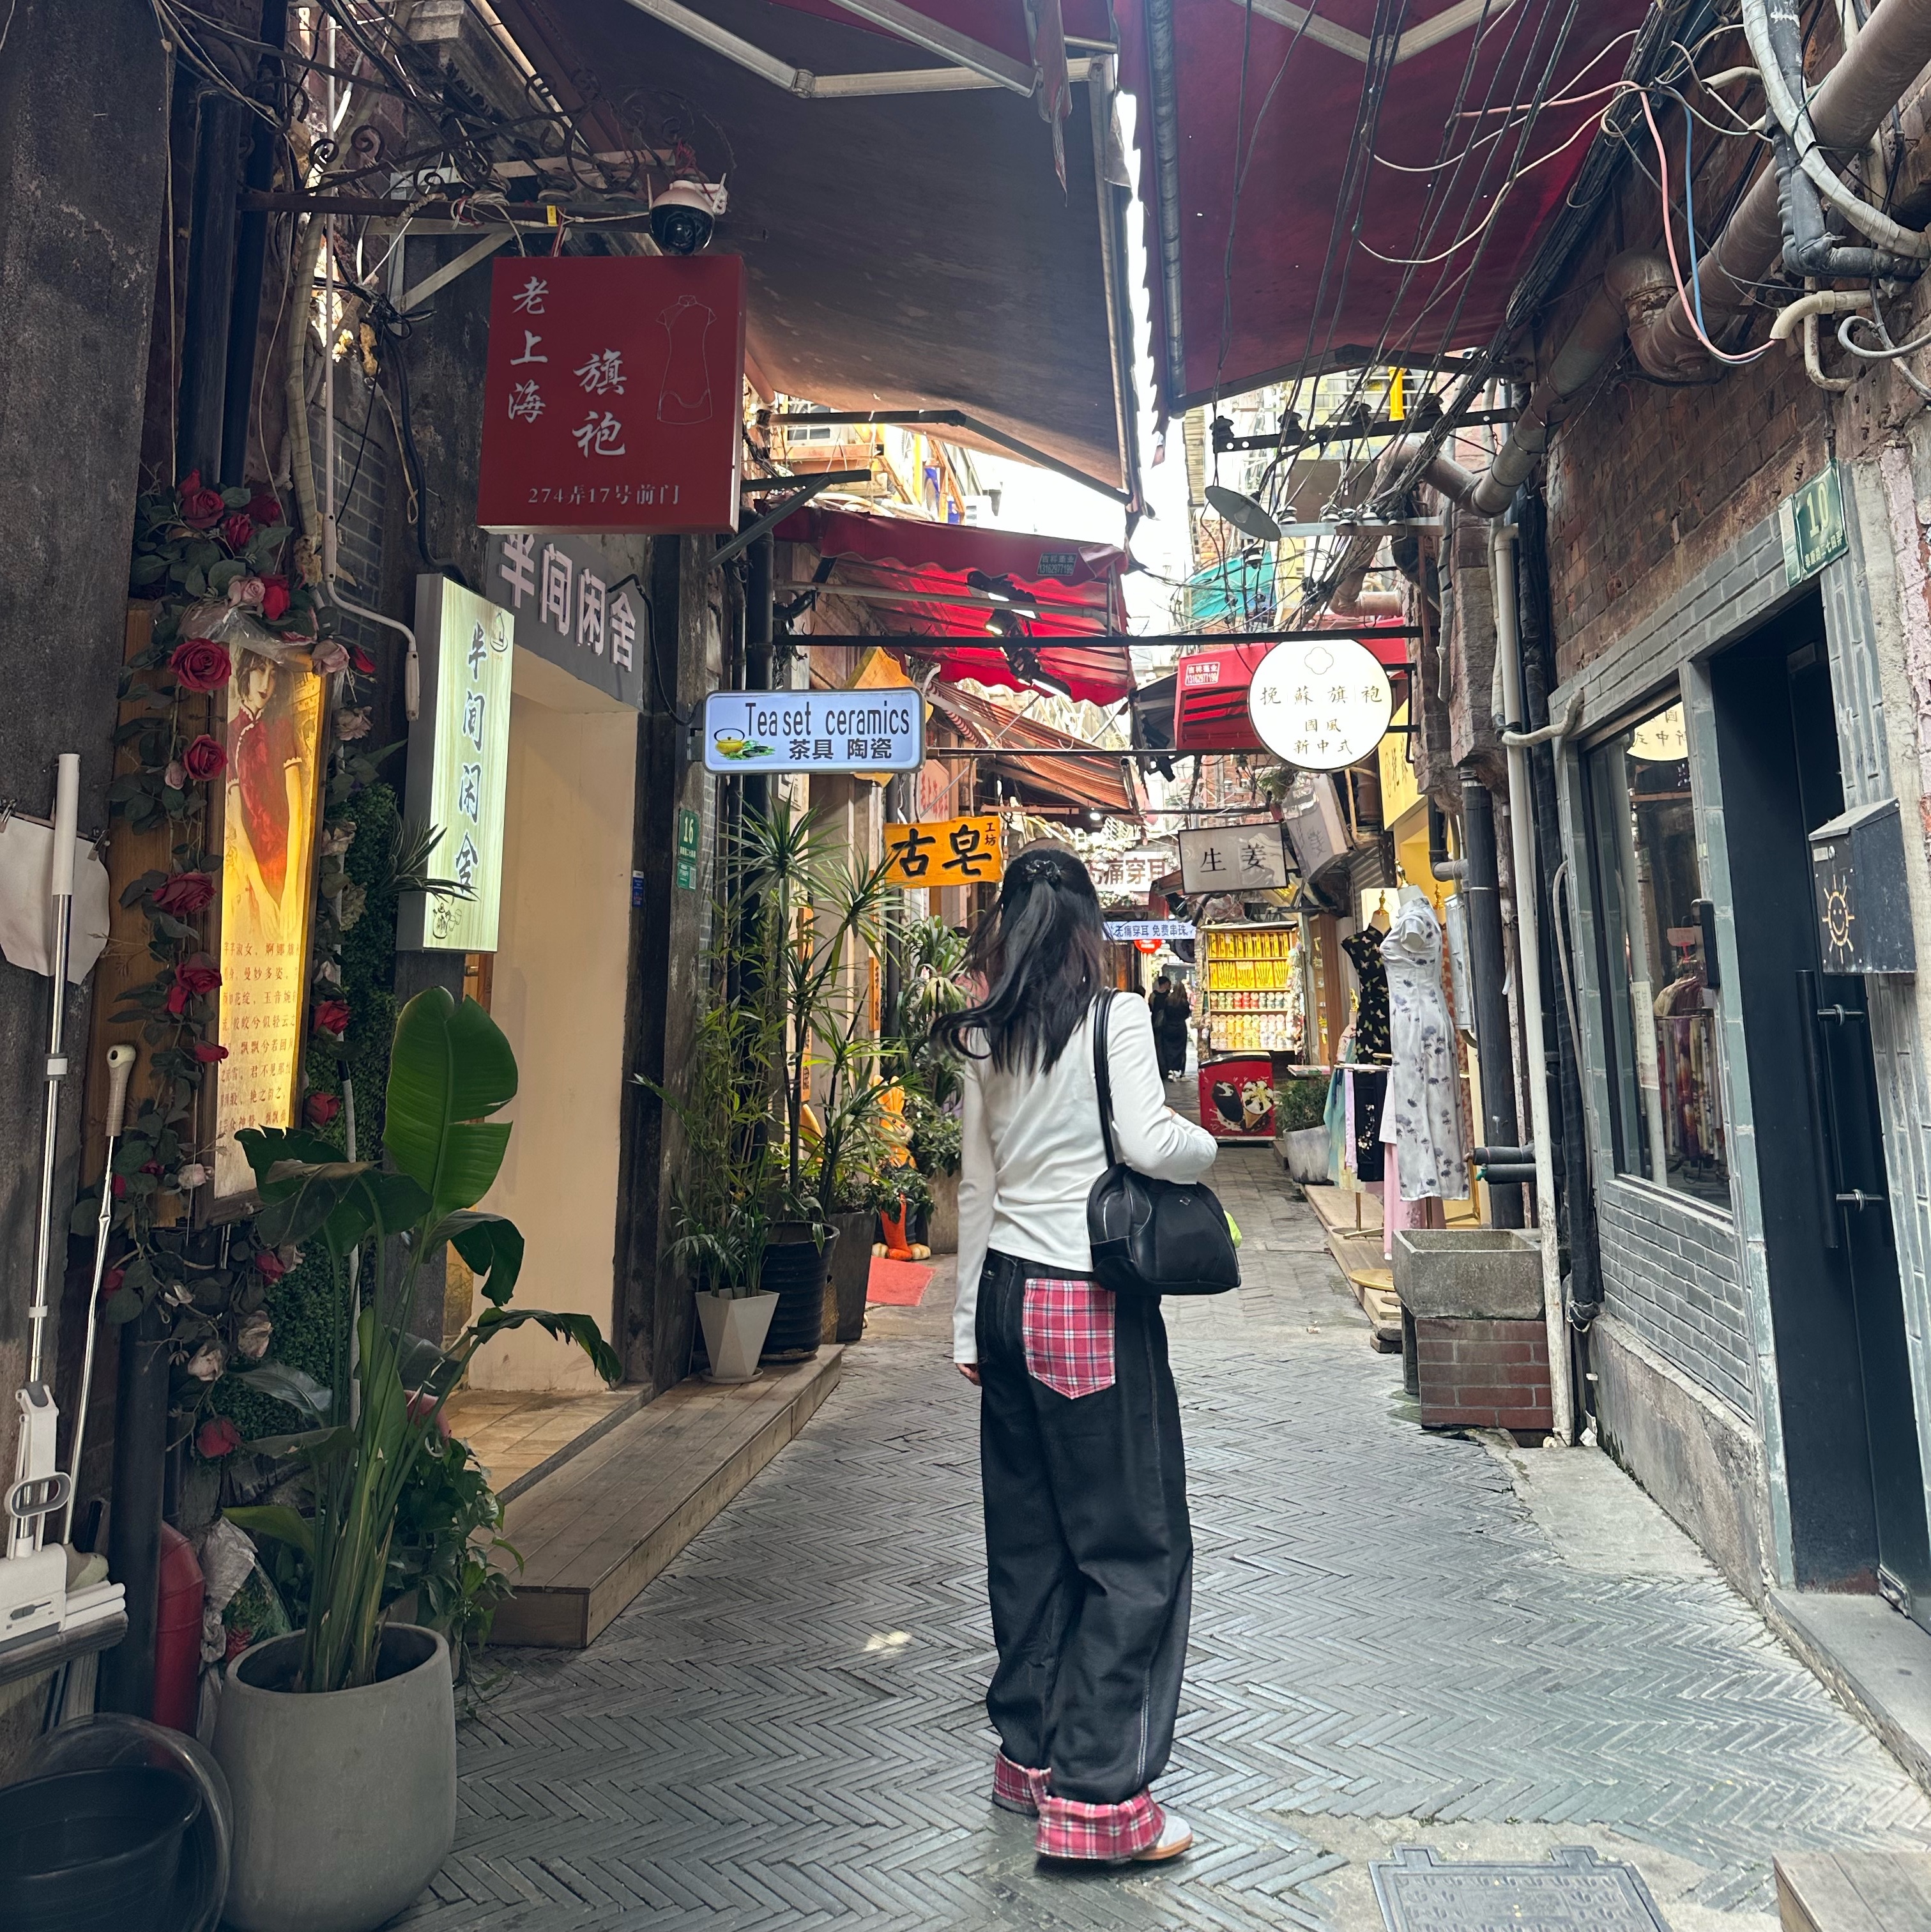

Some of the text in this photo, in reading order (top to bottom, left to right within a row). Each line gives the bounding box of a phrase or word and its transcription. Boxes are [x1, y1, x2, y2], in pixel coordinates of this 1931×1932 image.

[507, 276, 550, 424] 老上海
[572, 348, 628, 458] 旗袍
[528, 484, 680, 505] 274弄17号前门
[1806, 482, 1829, 539] 10
[499, 534, 637, 673] 半间闲舍
[745, 700, 910, 736] Tea set ceramics
[1305, 719, 1341, 732] 國風
[454, 621, 487, 895] 半间闲舍
[789, 737, 892, 760] 茶具 陶瓷
[1294, 739, 1353, 755] 新中式
[683, 816, 694, 844] 16
[984, 822, 996, 847] 工坊
[891, 824, 992, 877] 古皂
[1200, 843, 1267, 873] 生姜
[1152, 924, 1189, 937] 免费串珠
